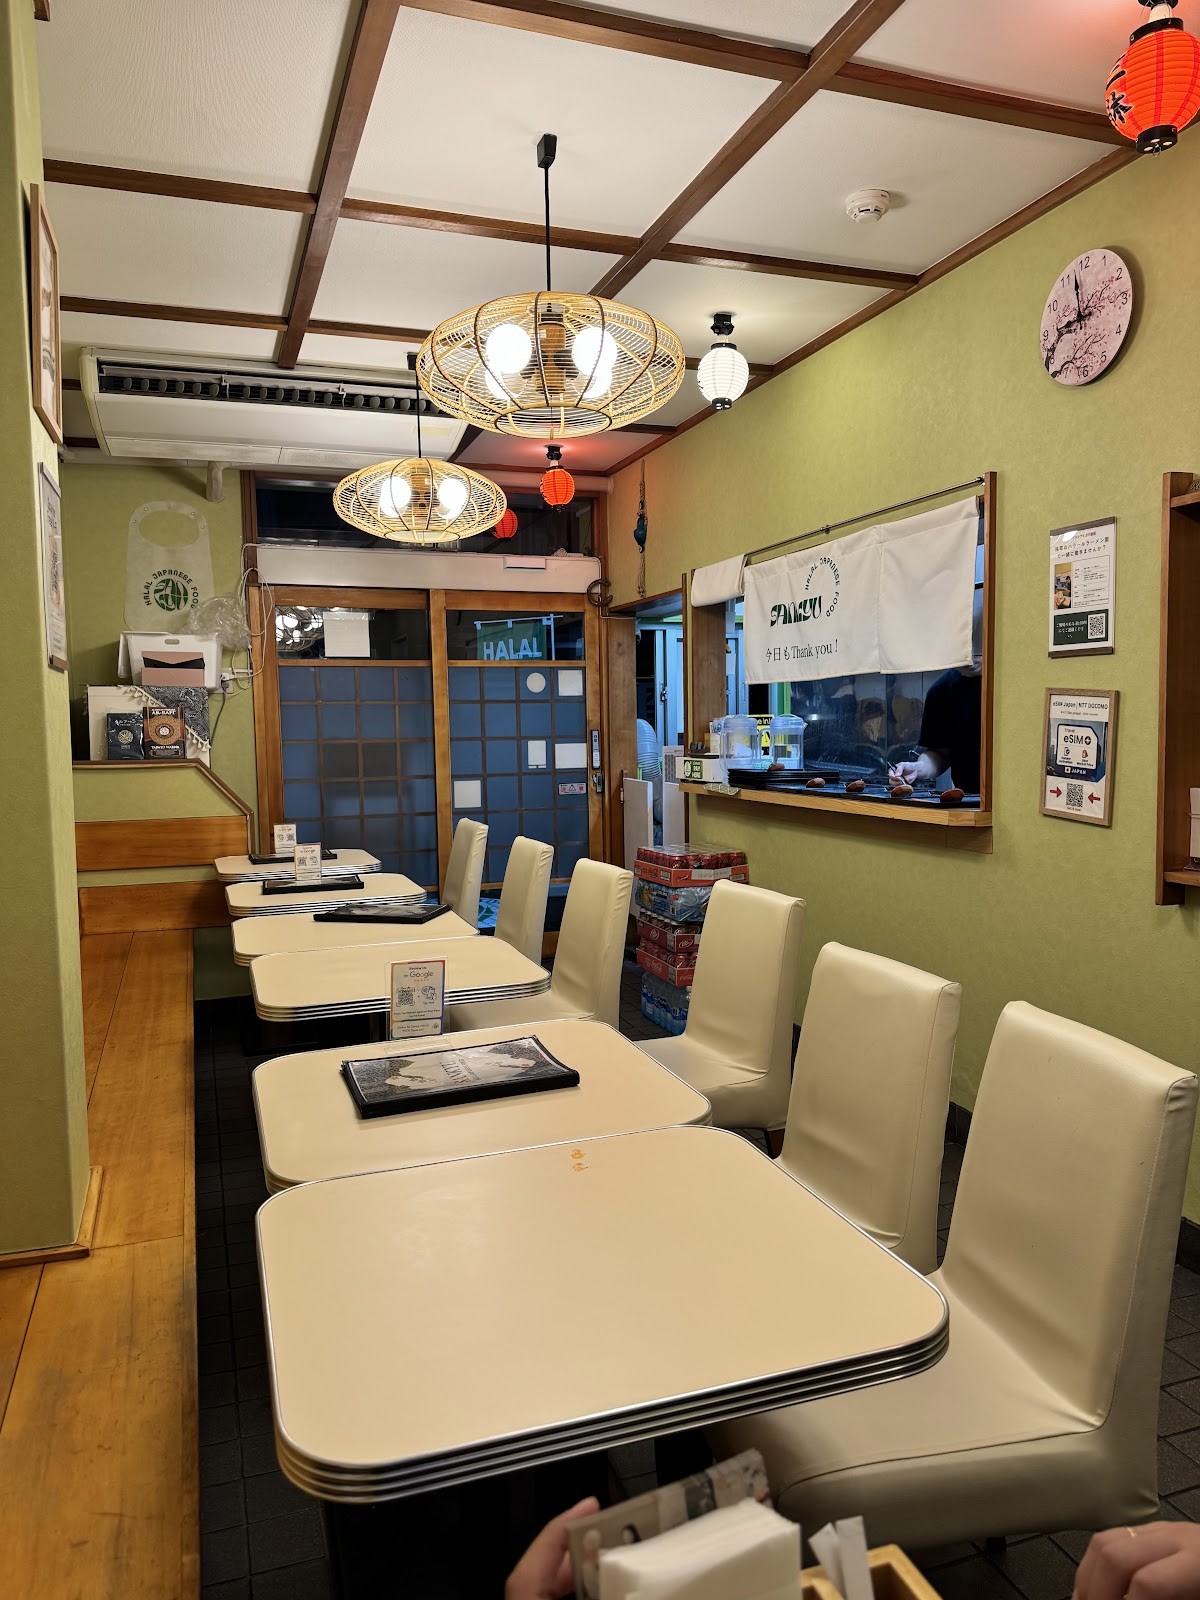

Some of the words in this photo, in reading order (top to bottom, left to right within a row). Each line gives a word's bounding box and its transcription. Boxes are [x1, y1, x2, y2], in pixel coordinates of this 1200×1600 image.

[1078, 256, 1091, 271] 12
[1101, 255, 1107, 267] 1
[1115, 267, 1123, 280] 2
[1060, 274, 1070, 288] 11
[1121, 292, 1128, 305] 3
[1047, 300, 1059, 314] 10
[1042, 330, 1049, 341] 9
[1115, 324, 1121, 336] 4
[1100, 350, 1107, 363] 5
[1083, 366, 1089, 378] 6
[805, 563, 819, 590] HALAL
[820, 557, 841, 587] JAPANESE
[143, 581, 153, 606] HALAL
[152, 569, 193, 585] JAPANESE
[825, 591, 840, 617] FOOD
[483, 637, 542, 660] HALAL
[765, 647, 790, 663] 今日も
[791, 644, 813, 659] Thank
[815, 643, 833, 659] you
[1063, 735, 1084, 744] eSIM
[409, 970, 434, 979] Google
